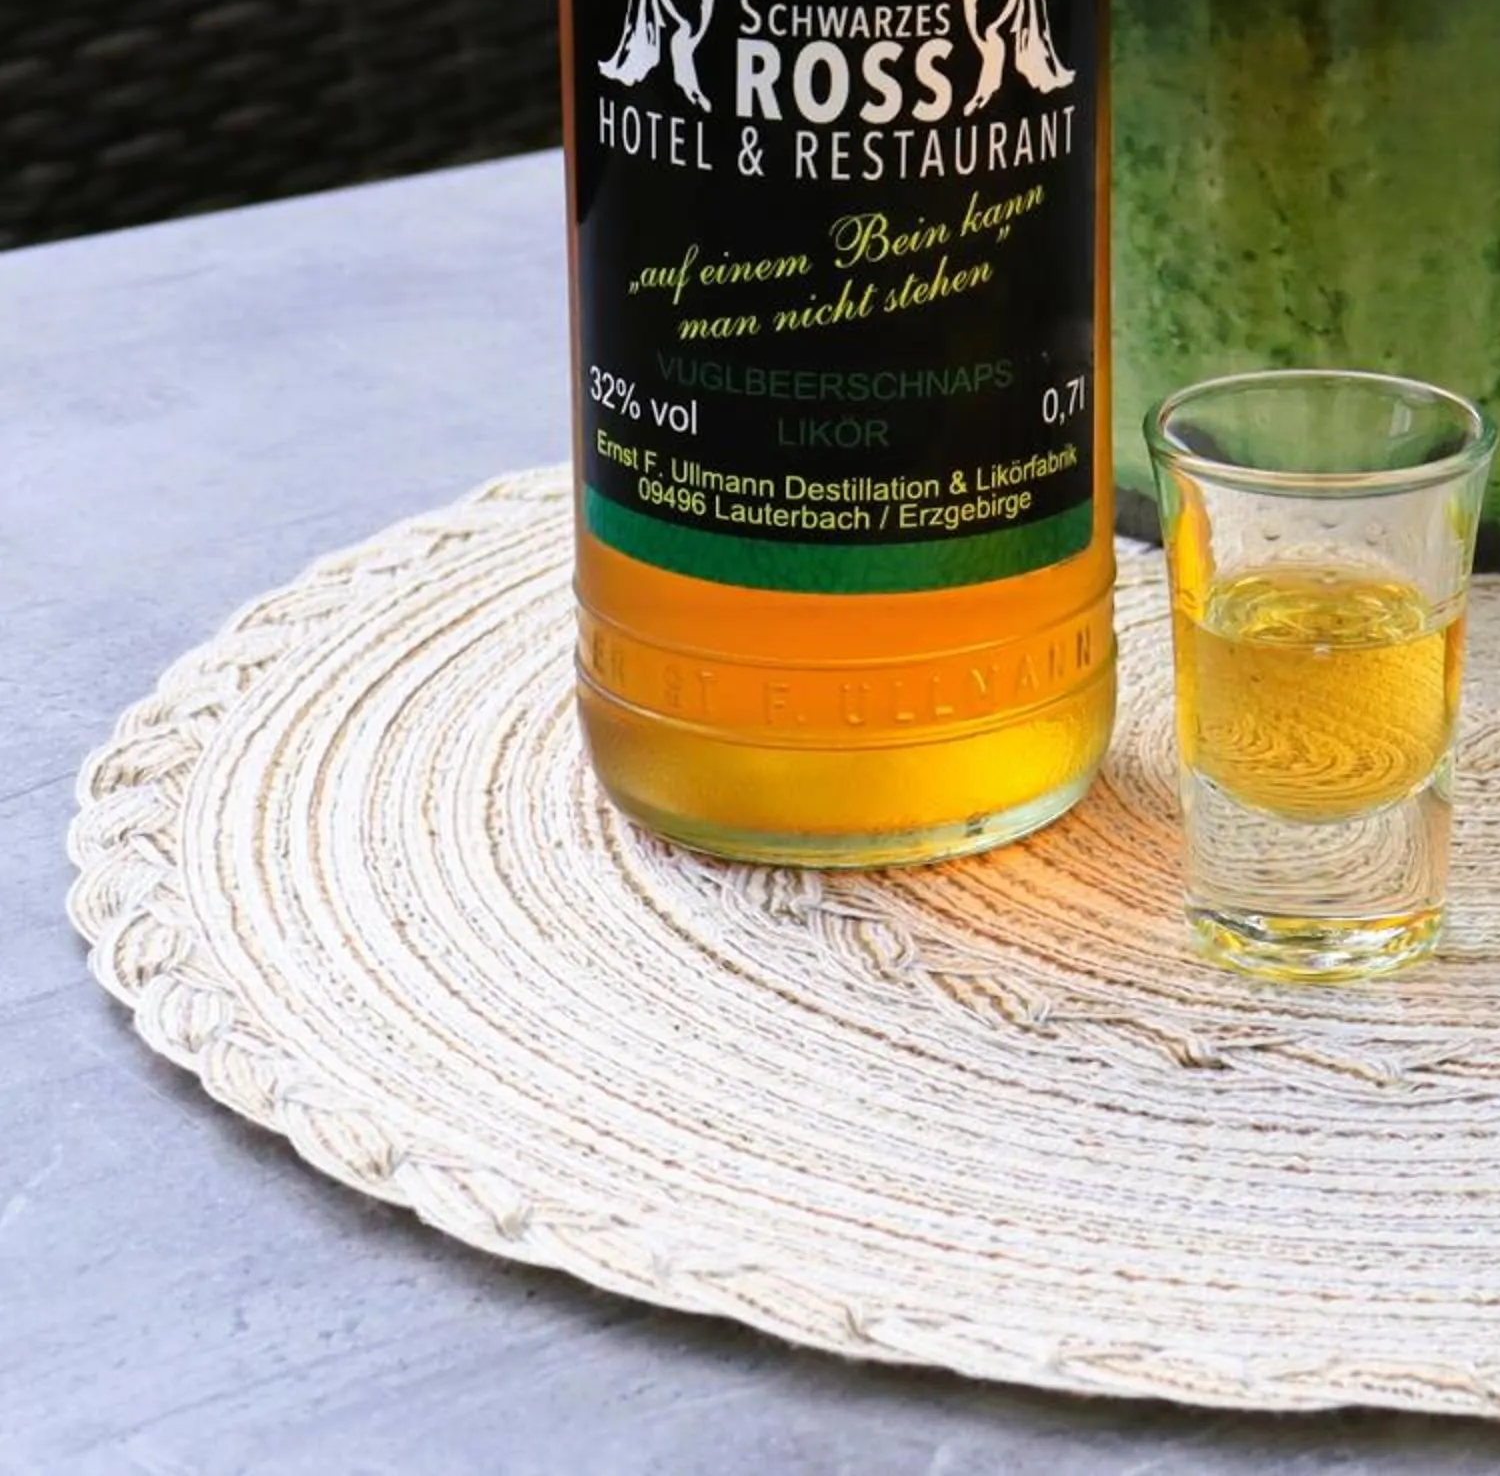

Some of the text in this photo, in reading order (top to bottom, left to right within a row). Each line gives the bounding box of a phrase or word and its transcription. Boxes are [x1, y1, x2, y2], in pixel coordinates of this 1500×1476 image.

[736, 38, 954, 123] ROSS
[600, 97, 1075, 181] HOTEL & RESTAURANT
[699, 251, 812, 286] einem
[829, 212, 951, 266] Bein
[960, 184, 1046, 237] kann
[676, 314, 762, 341] man
[773, 278, 877, 332] nicht
[589, 364, 698, 436] 32% vol
[656, 349, 1014, 402] VUGLBEERSCHNAPS
[596, 427, 1078, 503] Ernst F. Ullmann Destillation & Likörfabrik
[777, 413, 890, 448] LIKÖR
[638, 476, 706, 516] 09496
[715, 494, 870, 531] Lauterbach
[899, 491, 1032, 530] Erzgebirge
